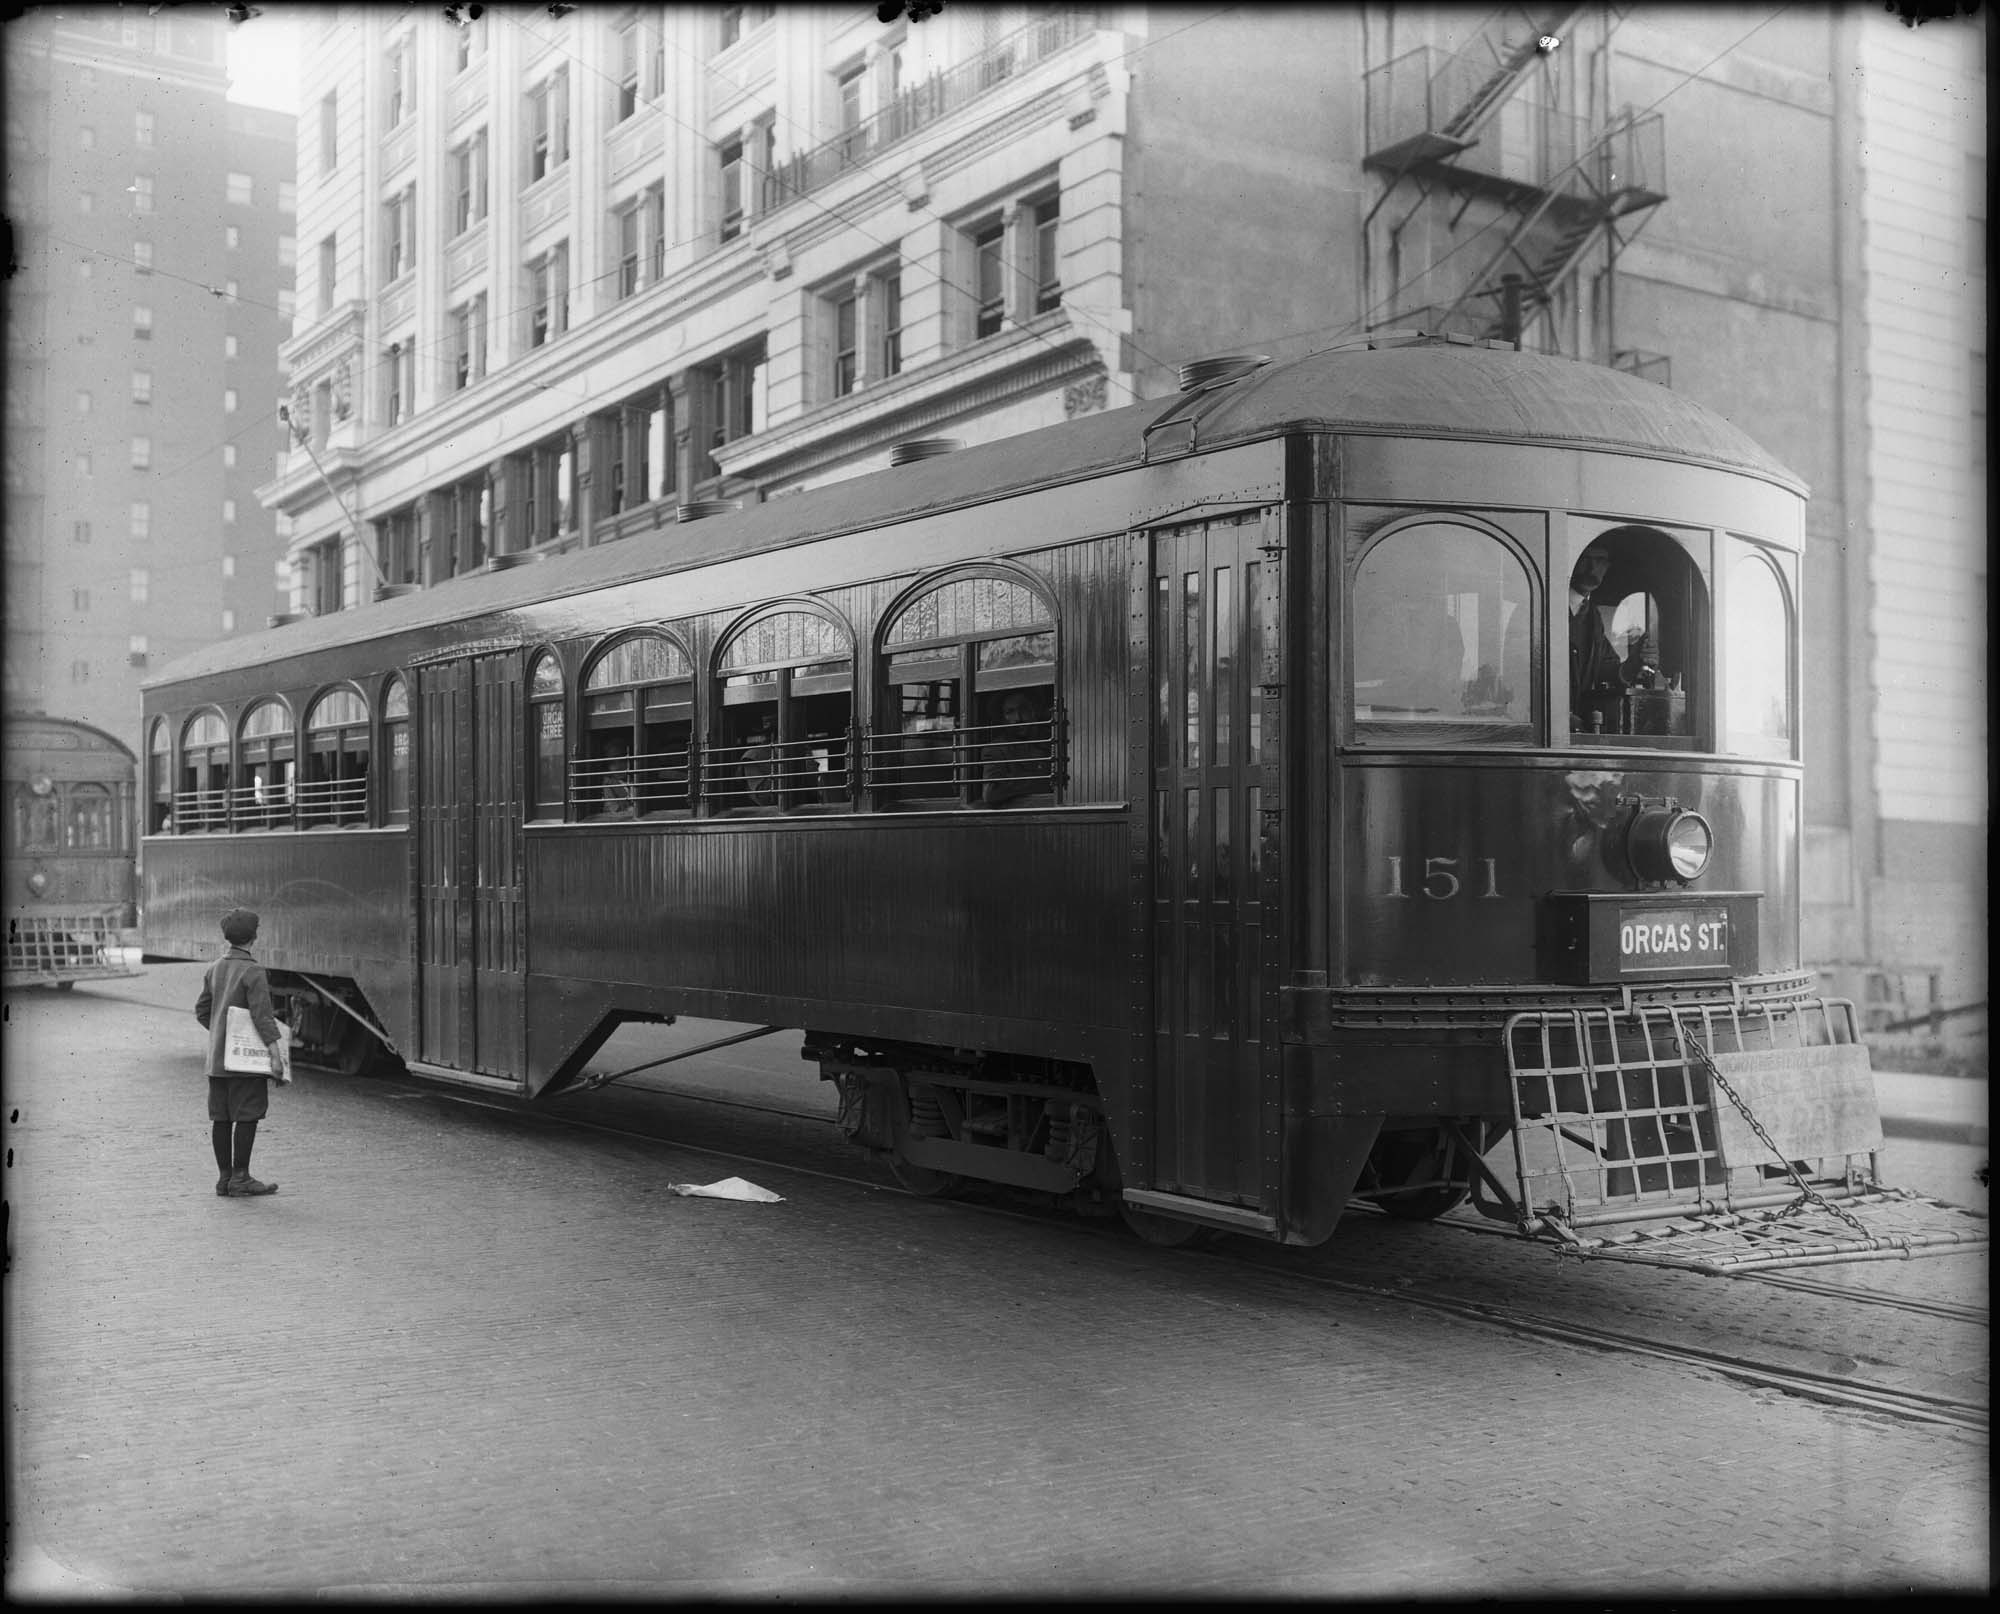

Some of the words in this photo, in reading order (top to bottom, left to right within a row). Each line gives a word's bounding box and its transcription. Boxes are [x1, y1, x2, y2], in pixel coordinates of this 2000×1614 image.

[543, 711, 563, 725] ORCA
[543, 724, 563, 738] STREE
[1388, 856, 1500, 900] 151
[1621, 923, 1692, 954] ORCAS
[1698, 922, 1725, 951] ST.
